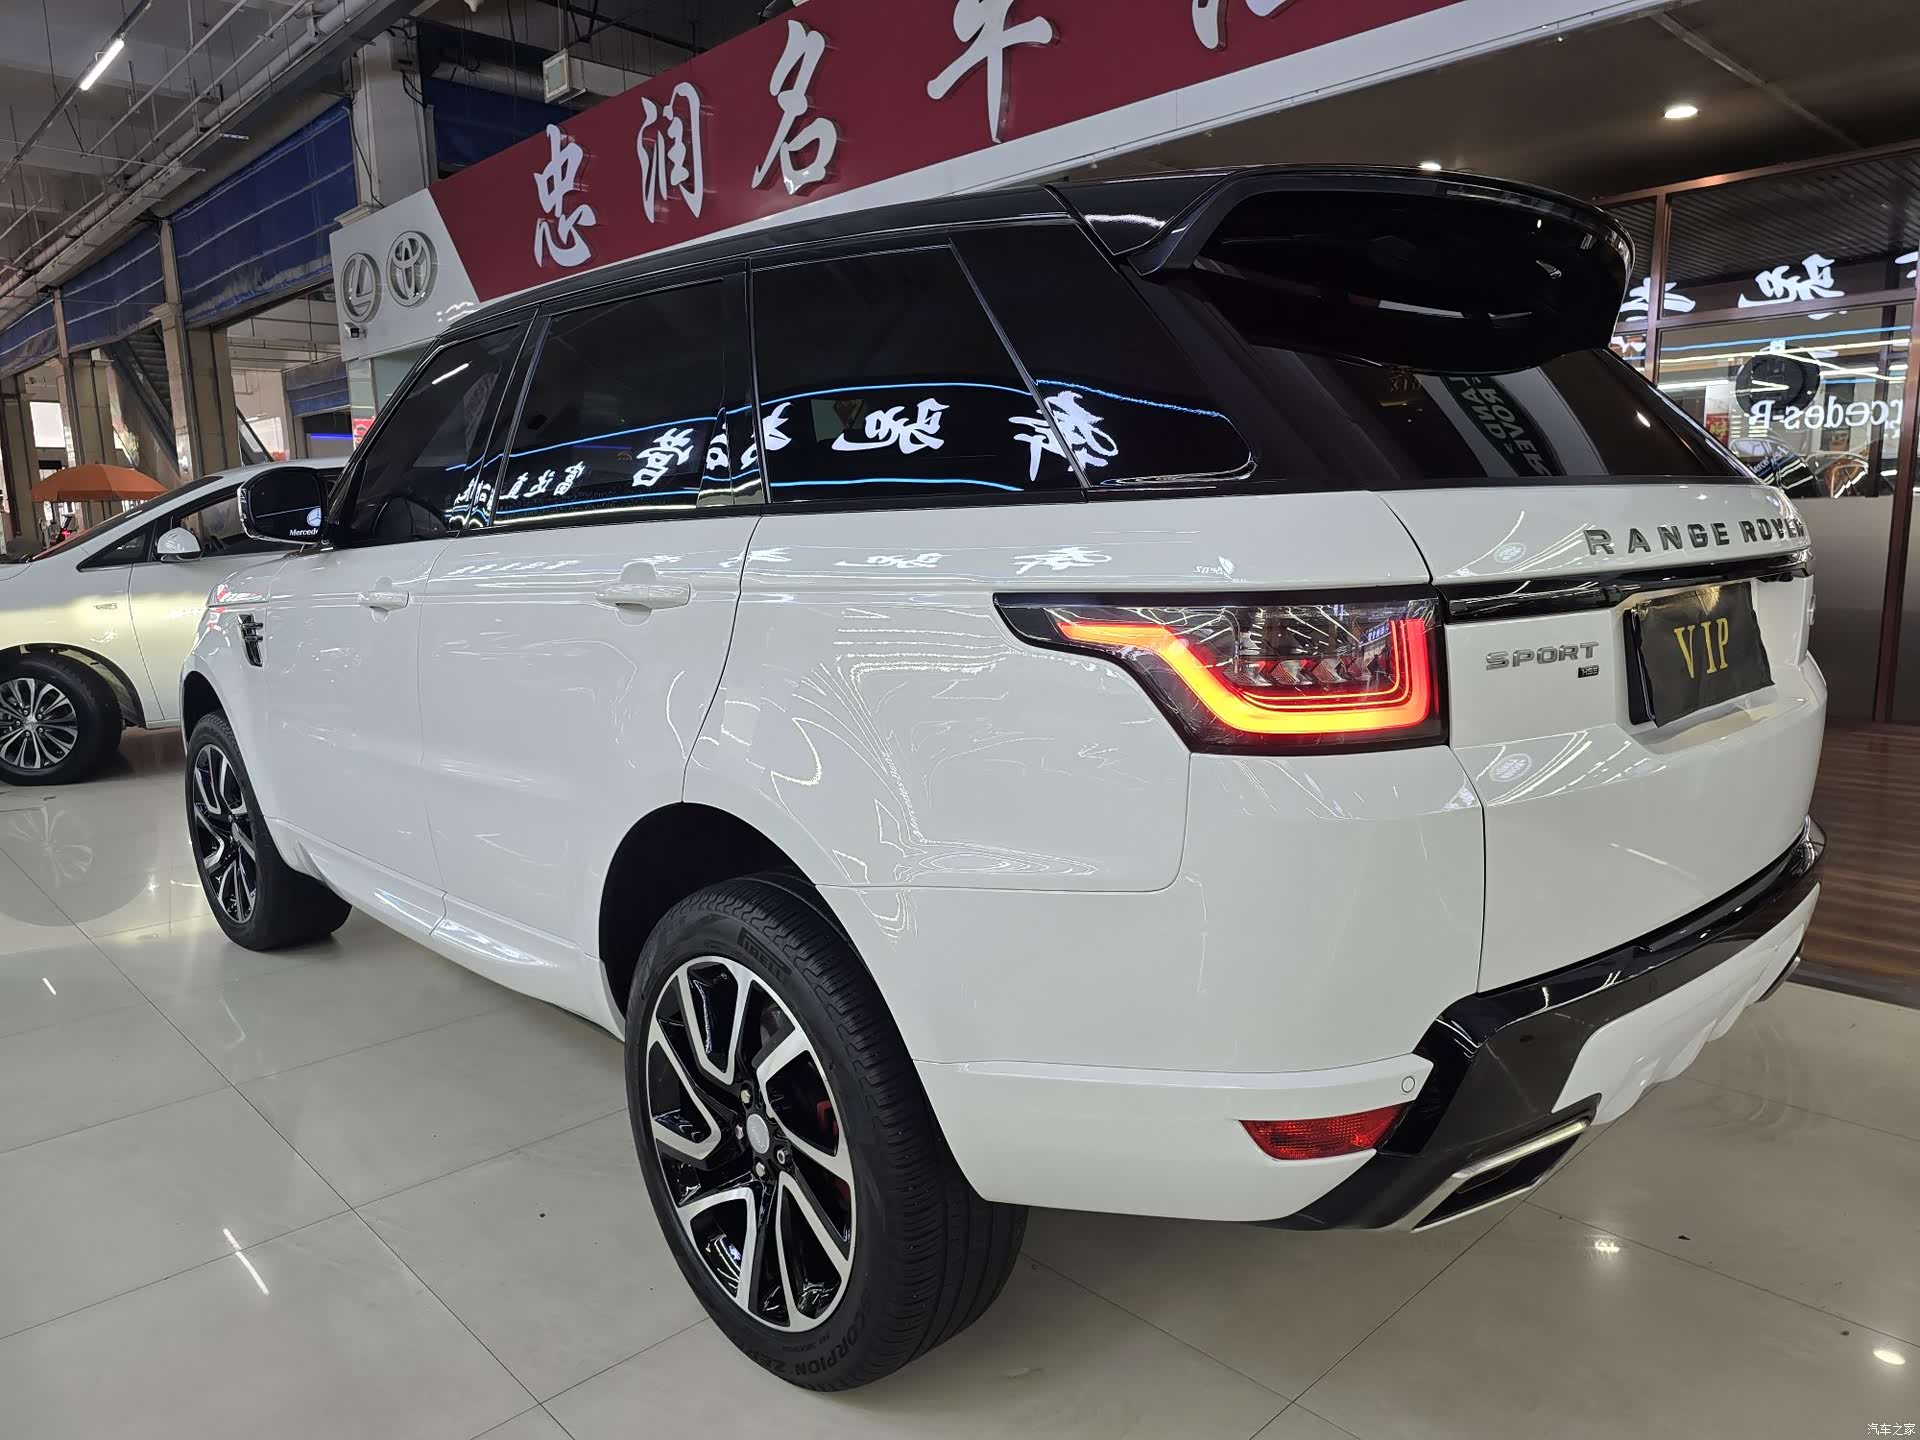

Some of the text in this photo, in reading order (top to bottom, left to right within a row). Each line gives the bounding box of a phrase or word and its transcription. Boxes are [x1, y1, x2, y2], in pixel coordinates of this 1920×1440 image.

[533, 0, 1296, 267] 忠润名车
[1583, 517, 1805, 556] RANGE ROVER
[1485, 641, 1600, 671] SPORT
[1674, 617, 1730, 679] VIP
[736, 926, 794, 985] PIRELL
